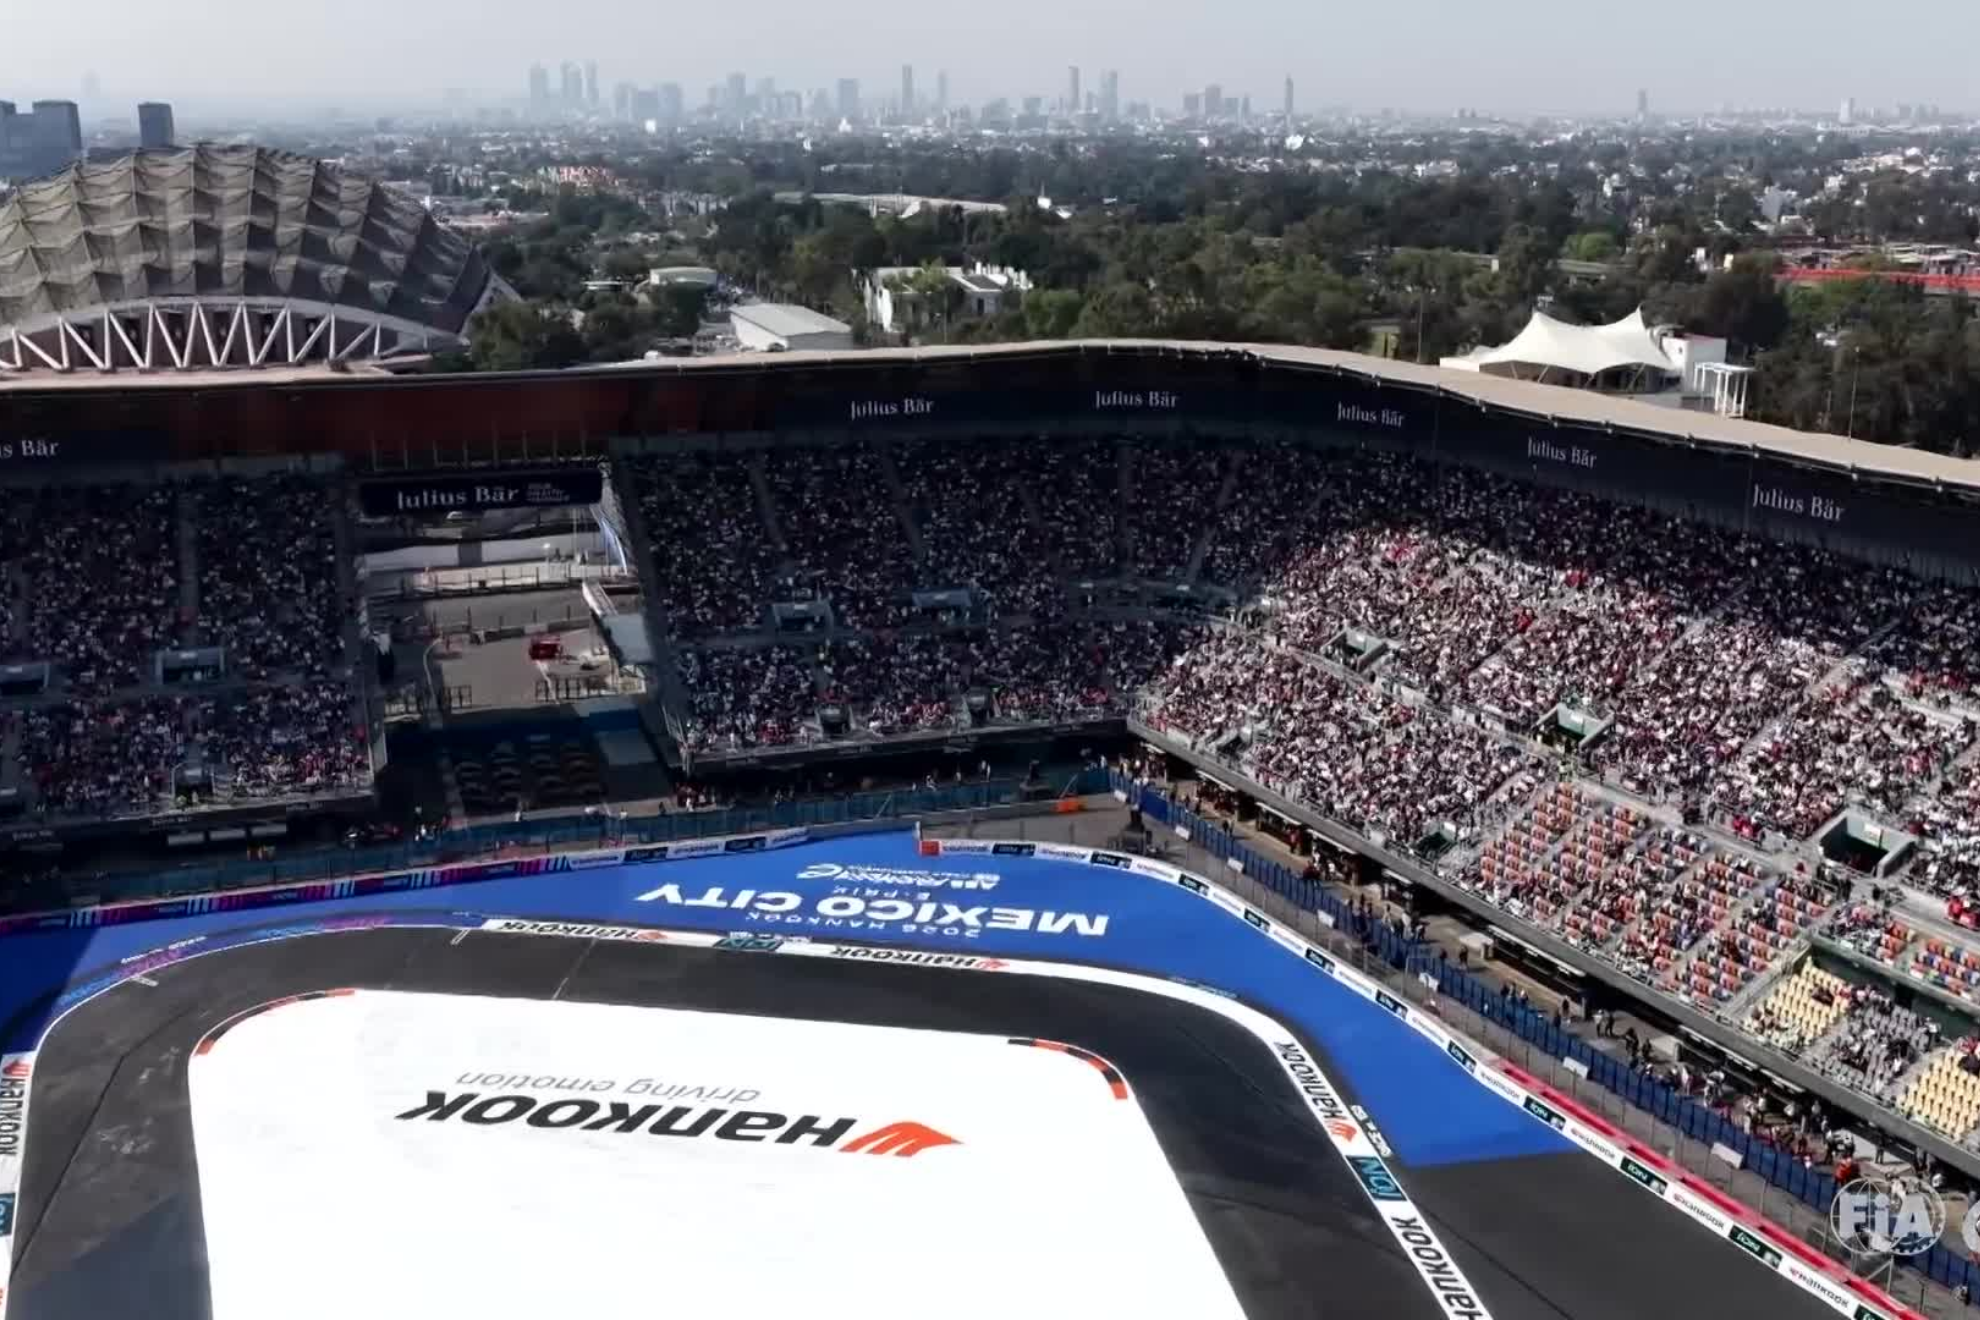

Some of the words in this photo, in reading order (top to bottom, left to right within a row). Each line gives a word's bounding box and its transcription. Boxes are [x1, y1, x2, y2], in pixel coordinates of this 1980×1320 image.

[850, 400, 898, 420] Julius
[903, 397, 935, 415] Bär
[1094, 388, 1143, 410] Julius
[1148, 388, 1179, 408] Bär
[1337, 400, 1377, 422] Julius
[1381, 408, 1405, 428] Bär
[21, 439, 60, 458] Bär
[1527, 436, 1567, 460] Julius
[1571, 446, 1597, 470] Bär
[397, 488, 467, 510] Julius
[475, 483, 519, 503] Bär
[1752, 483, 1804, 513] Julius
[1810, 496, 1846, 520] Bär
[633, 882, 803, 912] CITY
[746, 911, 887, 930] HANKOOK
[817, 895, 1109, 937] MEXICO
[455, 1071, 615, 1094] emotion
[625, 1077, 761, 1105] driving
